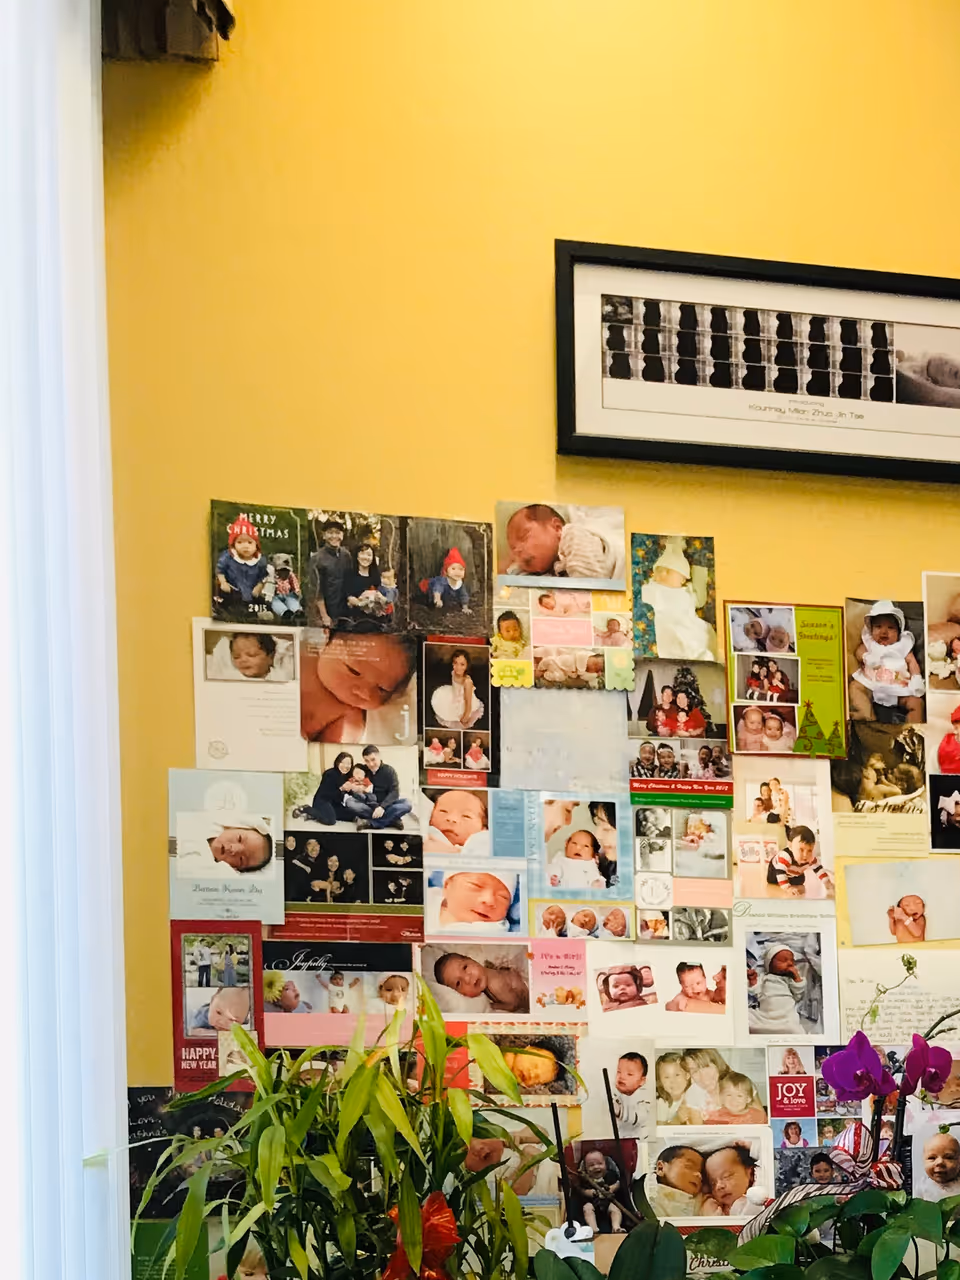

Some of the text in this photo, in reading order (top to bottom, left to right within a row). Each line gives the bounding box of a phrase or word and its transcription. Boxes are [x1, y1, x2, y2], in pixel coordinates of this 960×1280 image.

[239, 512, 277, 524] MERRY
[226, 523, 289, 539] CHRISTMAS
[247, 603, 267, 613] 2015
[181, 1047, 216, 1060] HAPPY
[181, 1060, 217, 1069] NEW YEAR
[776, 1082, 807, 1101] JOY
[782, 1096, 806, 1104] & love
